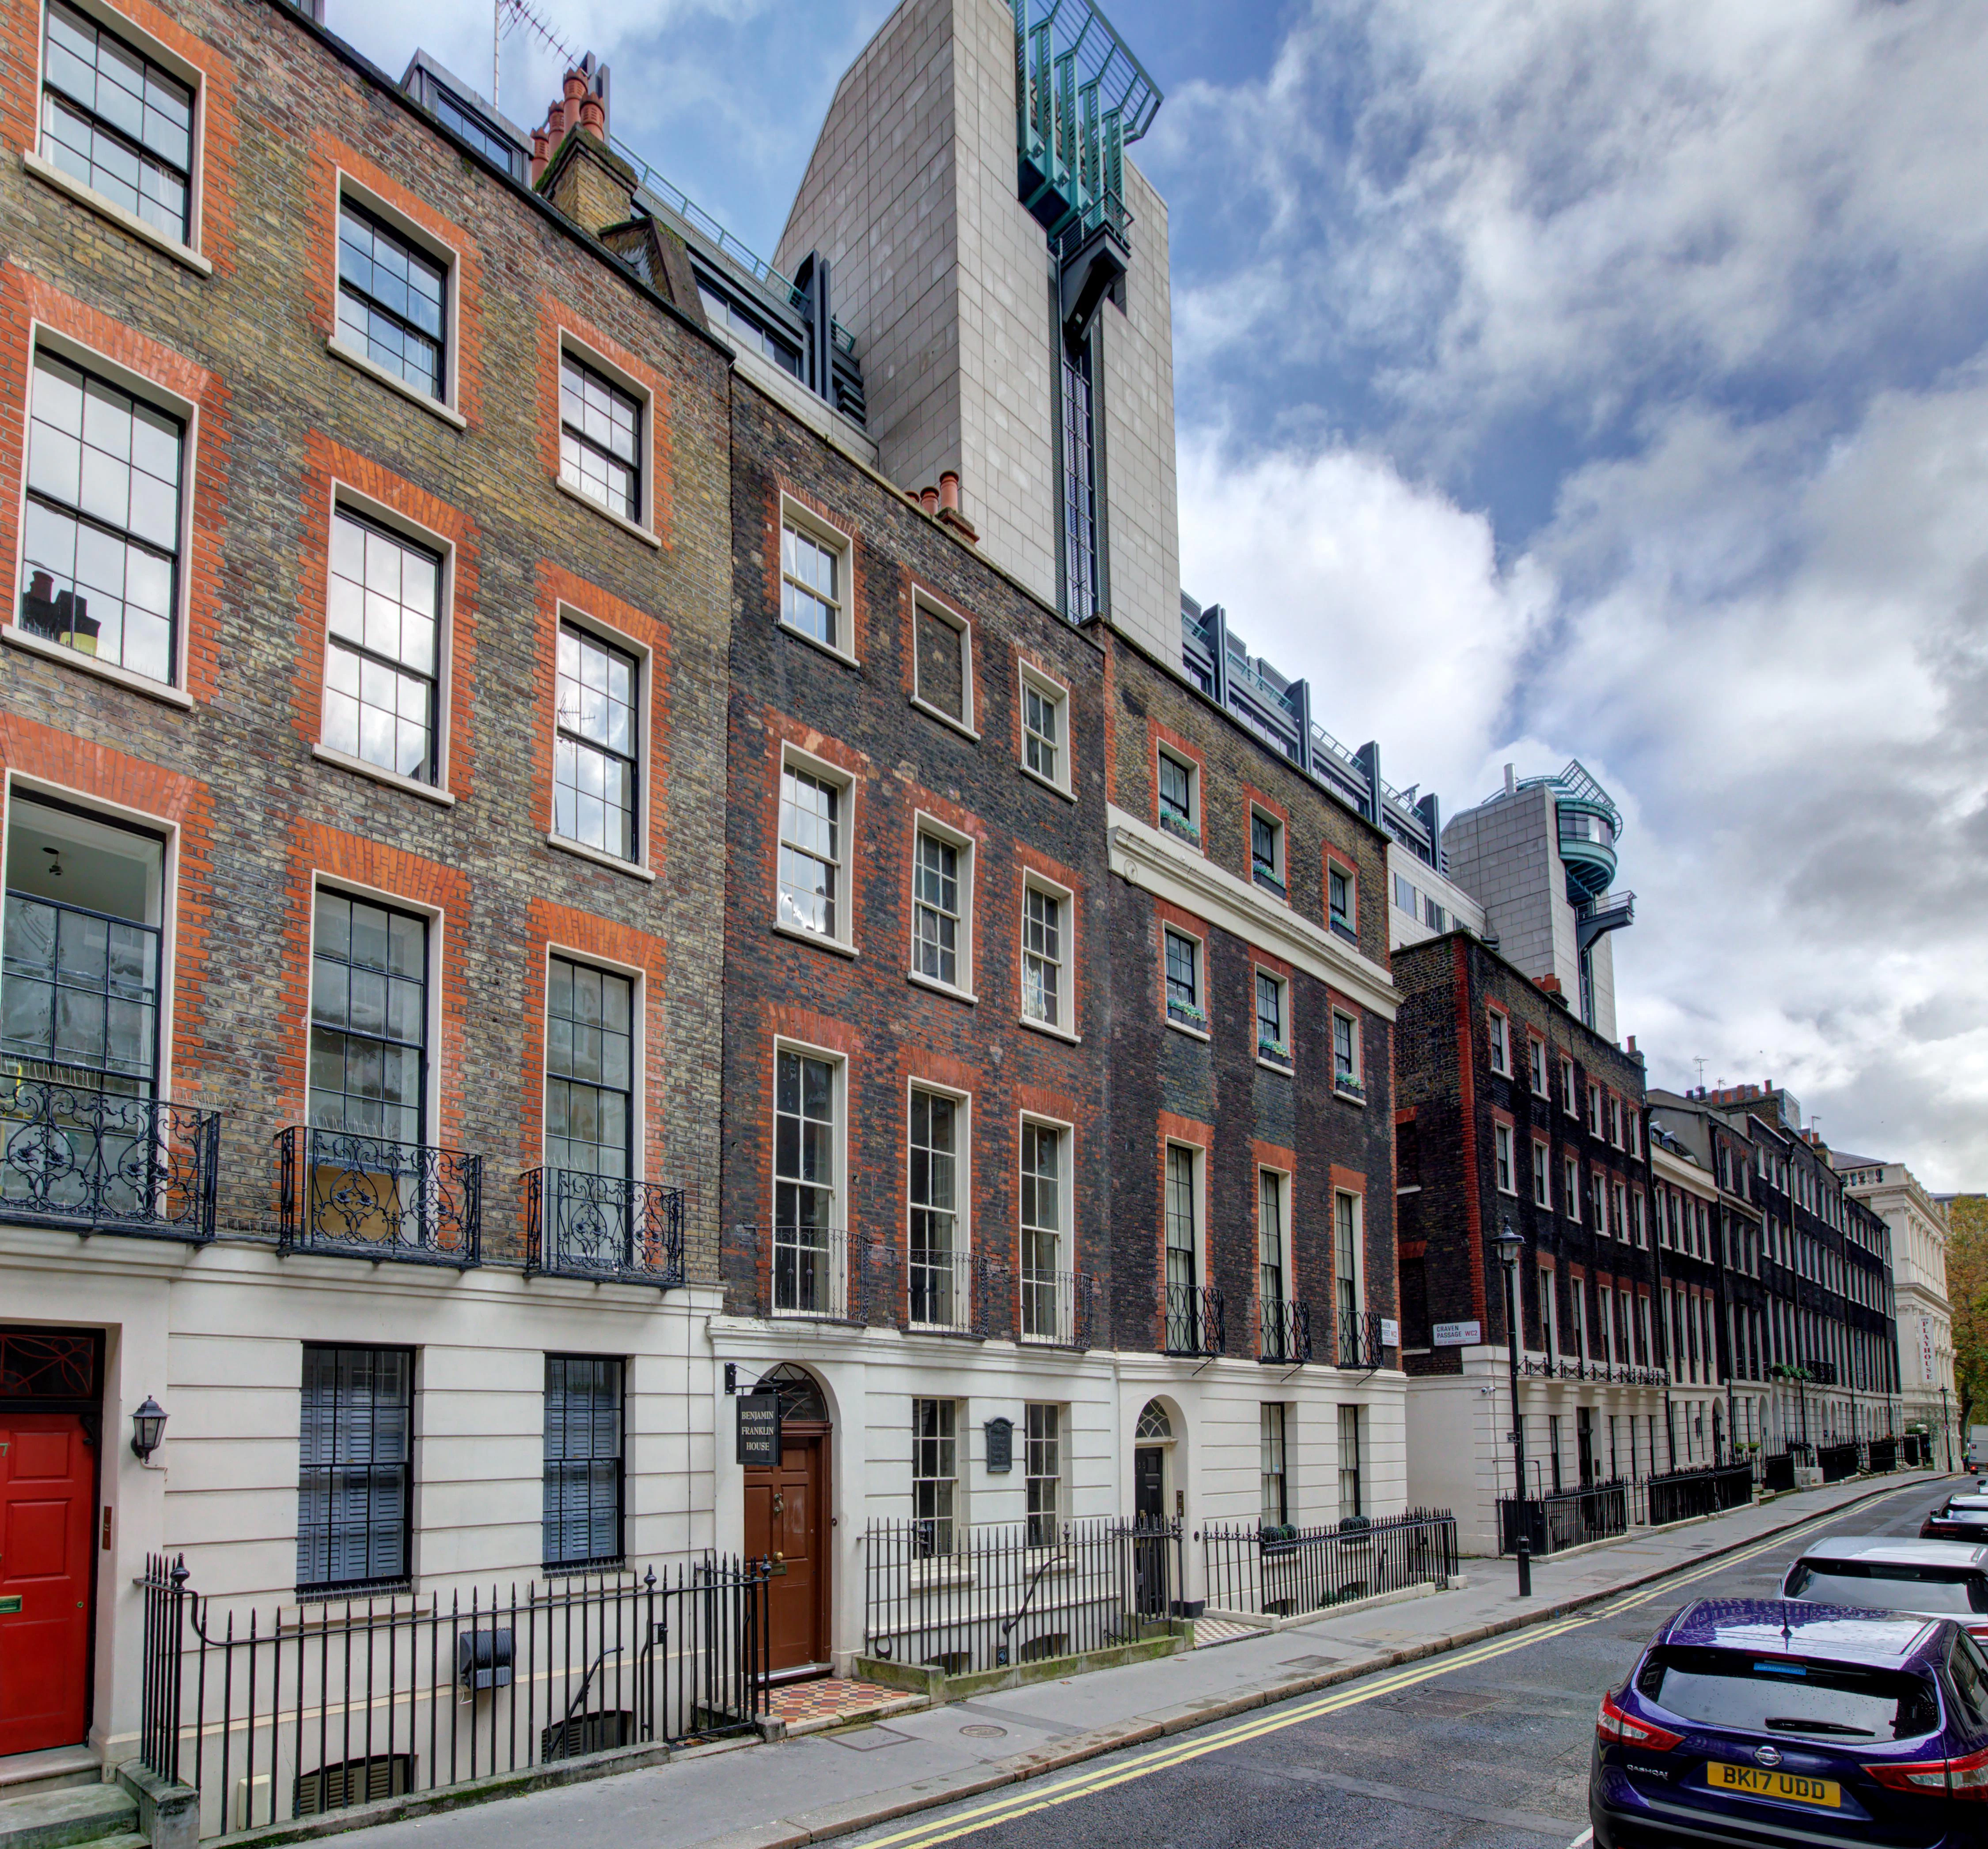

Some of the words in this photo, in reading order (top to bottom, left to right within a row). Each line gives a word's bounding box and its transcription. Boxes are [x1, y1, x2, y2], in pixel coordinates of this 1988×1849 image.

[1923, 1321, 1933, 1380] PLAYHOUSE
[741, 1411, 774, 1421] BENJAMIN
[741, 1427, 774, 1435] FRANKLIN
[746, 1442, 770, 1451] HOUSE
[1627, 1765, 1668, 1777] QASHQAI
[1723, 1766, 1772, 1790] BK17
[1779, 1776, 1825, 1800] UDD
